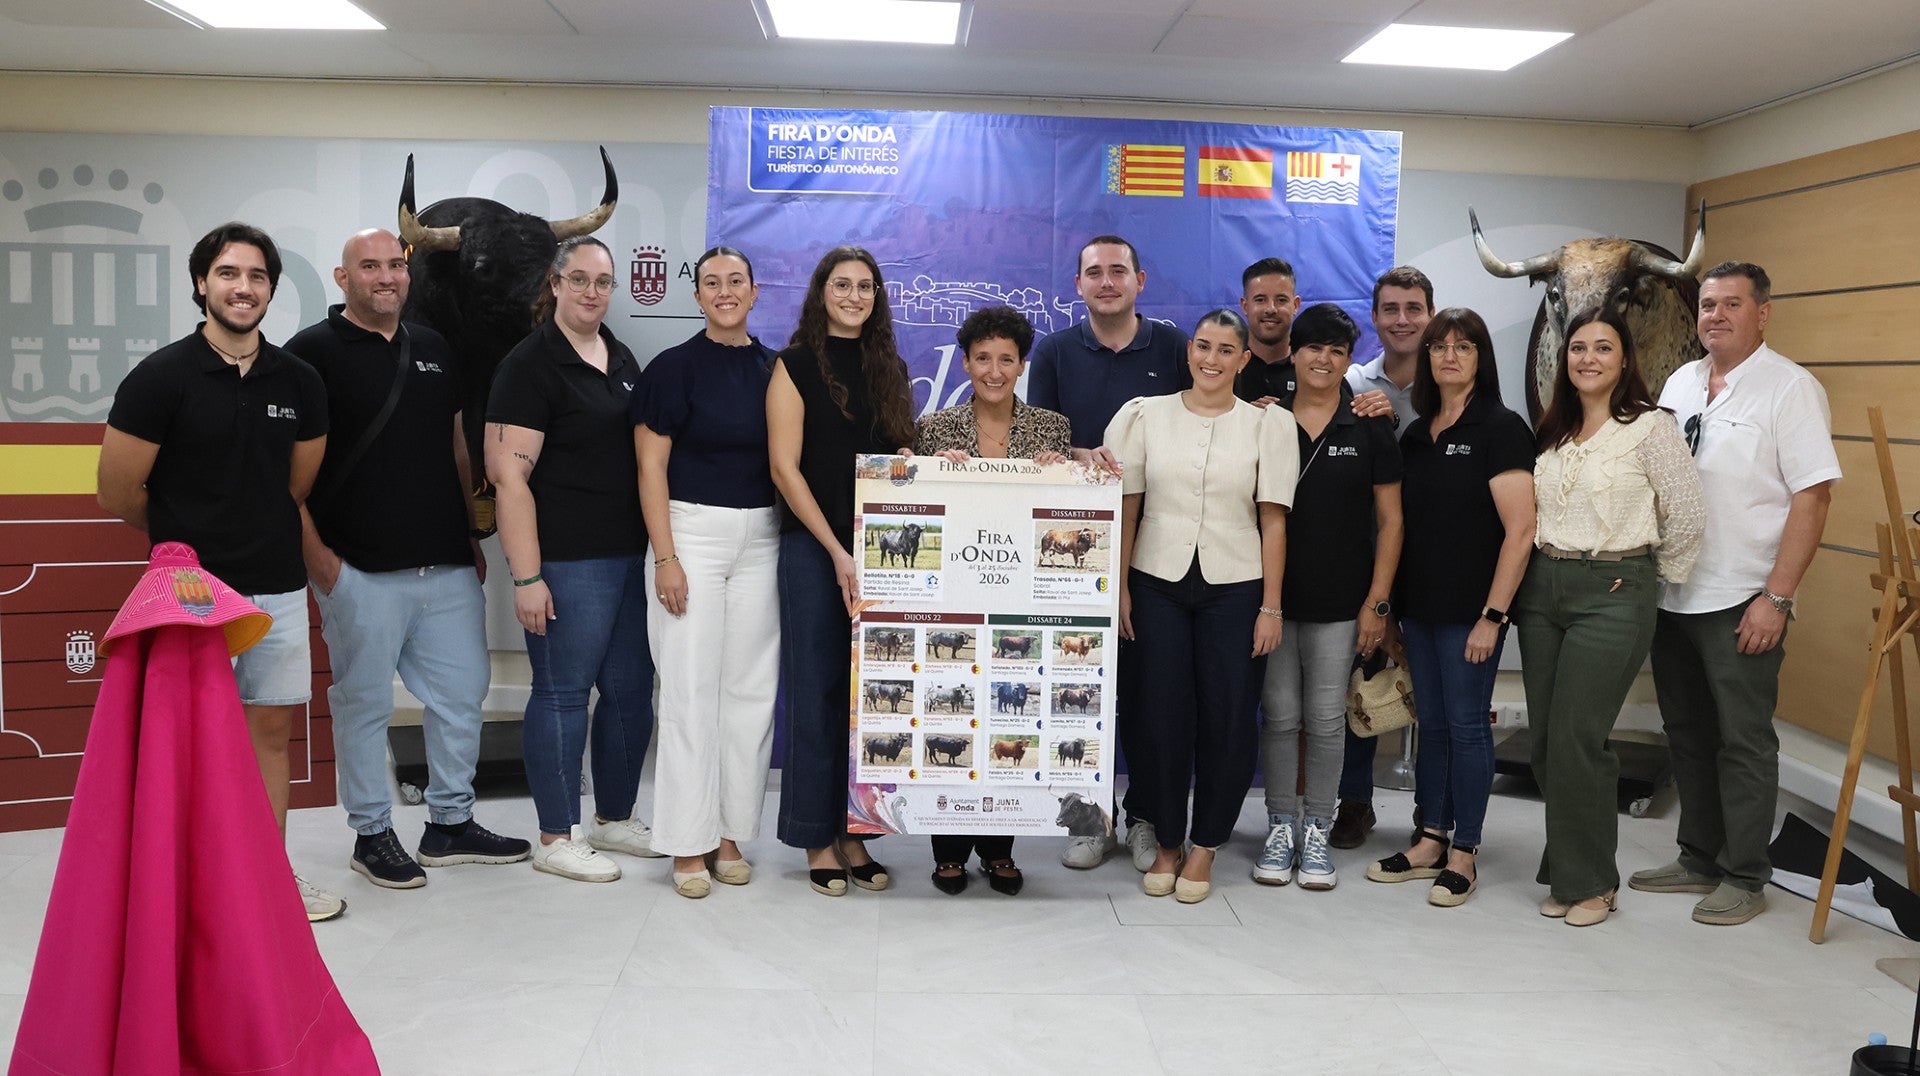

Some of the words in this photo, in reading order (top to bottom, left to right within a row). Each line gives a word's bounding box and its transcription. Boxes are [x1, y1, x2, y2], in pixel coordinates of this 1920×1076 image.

[768, 124, 813, 141] FIRA
[768, 145, 815, 160] FIESTA
[819, 146, 837, 160] DE
[841, 145, 899, 162] INTERÉS
[767, 161, 822, 173] TURÍSTICO
[823, 163, 899, 175] AUTONÓMICO
[1020, 465, 1042, 474] 2026
[881, 504, 917, 513] DISSABTE
[918, 505, 927, 513] 17
[1051, 509, 1086, 518] DISSABTE
[977, 529, 1014, 545] FIRA
[979, 573, 1010, 585] 2026
[904, 613, 932, 622] DIJOUS
[932, 614, 942, 622] 22
[1027, 616, 1063, 625] DISSABTE
[954, 804, 975, 812] Onda
